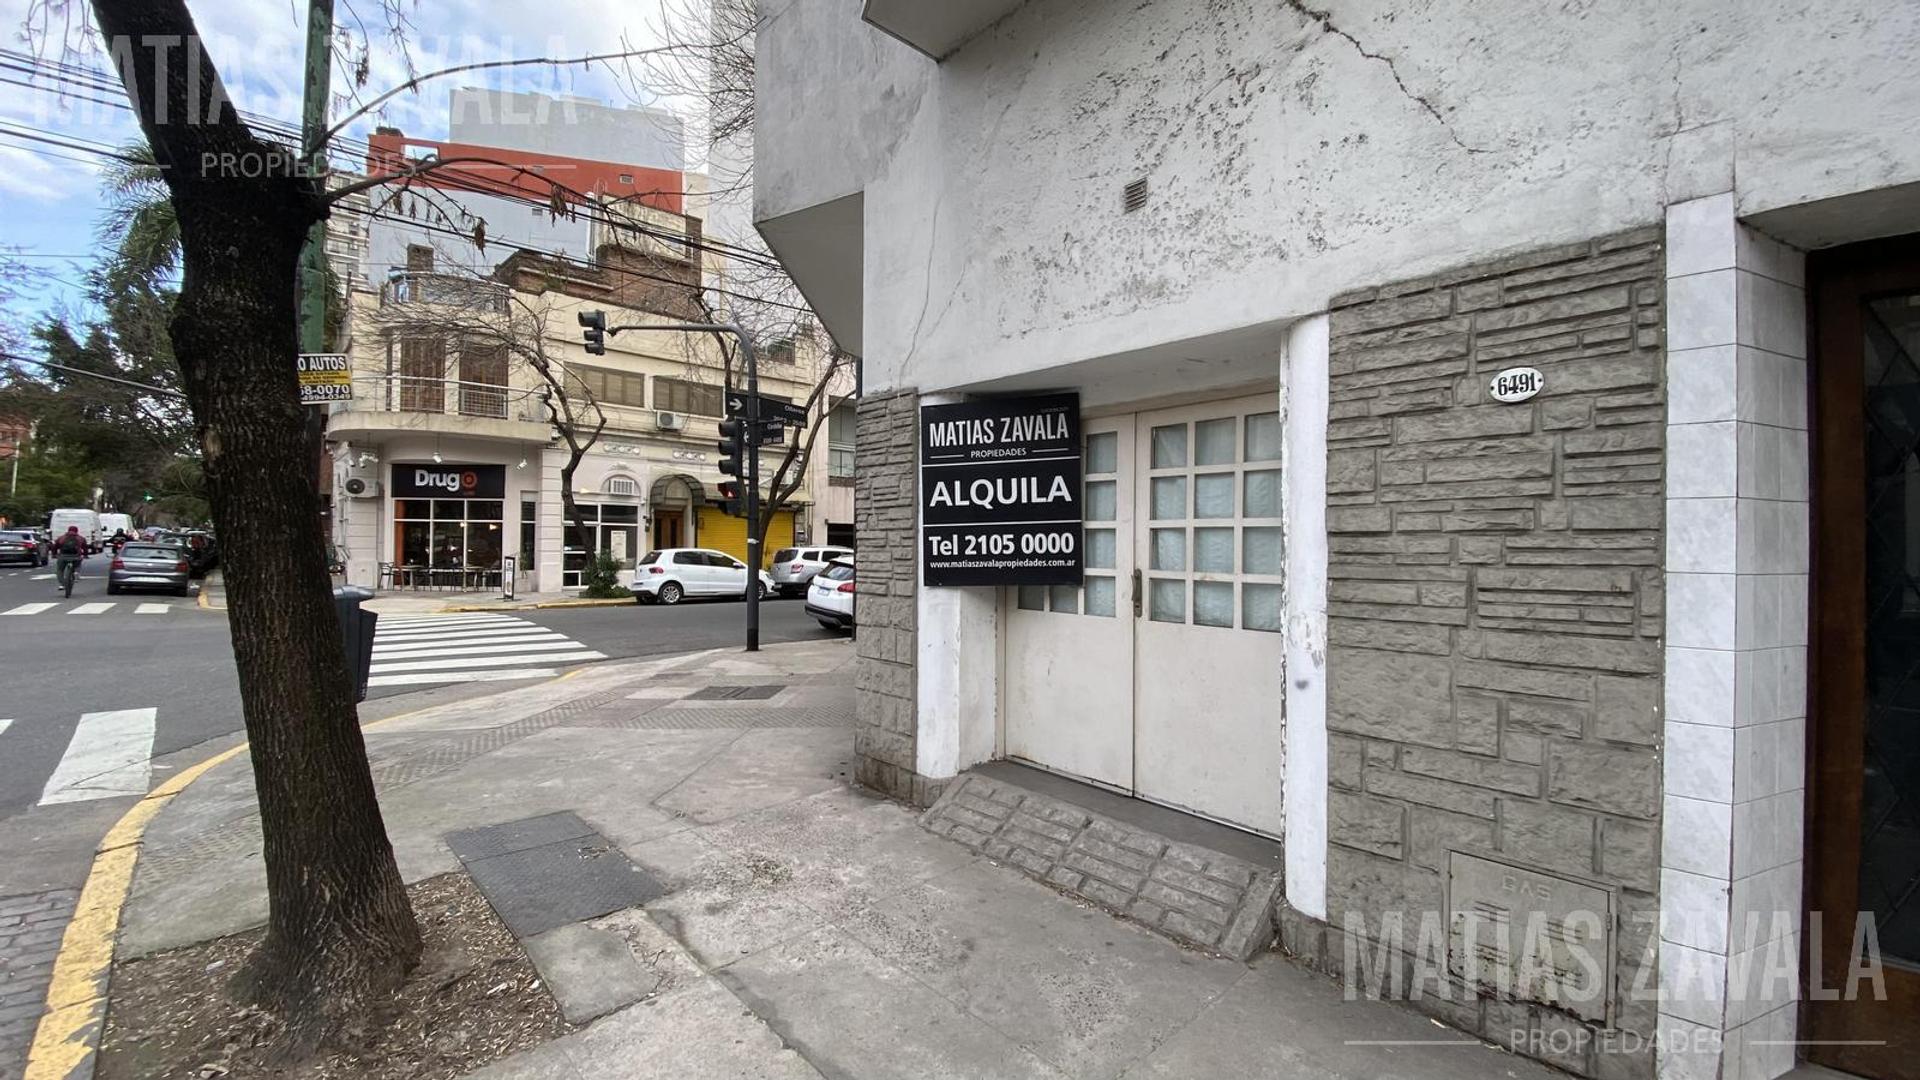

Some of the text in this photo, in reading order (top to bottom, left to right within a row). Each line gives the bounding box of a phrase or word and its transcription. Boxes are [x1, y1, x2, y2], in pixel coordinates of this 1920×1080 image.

[309, 357, 346, 370] AUTOS
[1497, 372, 1537, 396] 6491
[929, 412, 1069, 447] MATIAS ZAVALA
[970, 447, 1027, 458] PROPIEDADES
[929, 475, 1073, 510] ALQUILA
[928, 532, 1075, 556] Tel 2105 0000
[929, 557, 1076, 569] www.matiaszavalapropiedades.com.ar
